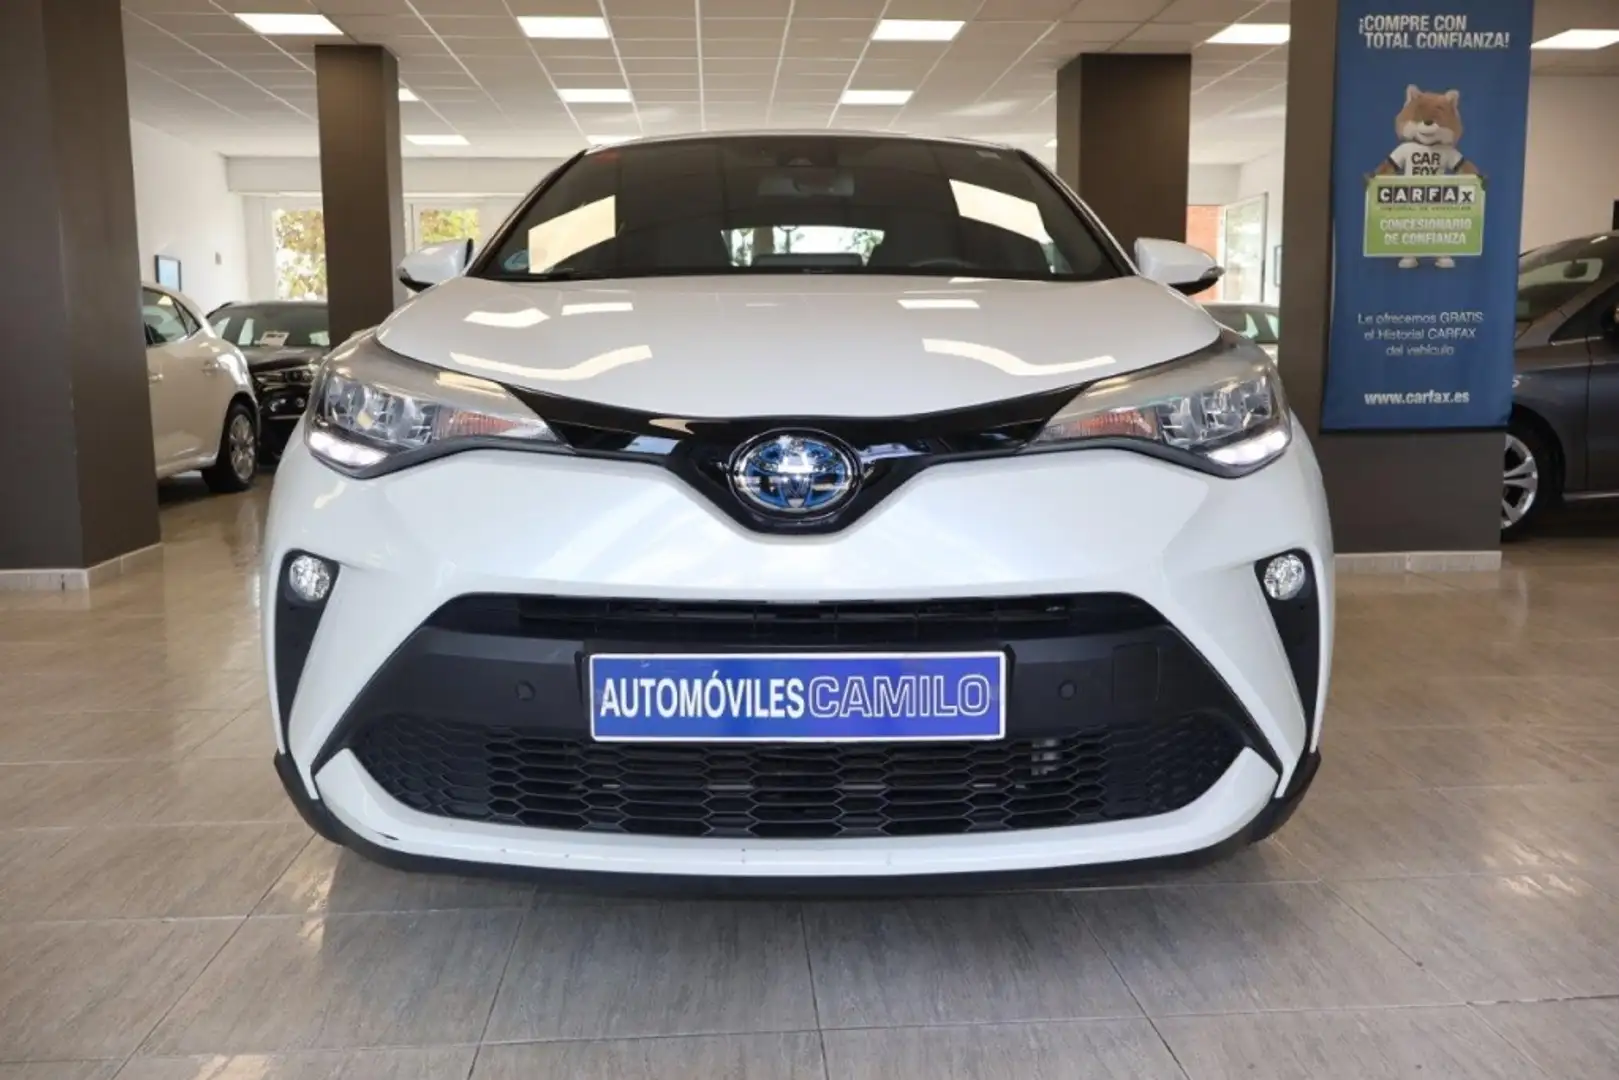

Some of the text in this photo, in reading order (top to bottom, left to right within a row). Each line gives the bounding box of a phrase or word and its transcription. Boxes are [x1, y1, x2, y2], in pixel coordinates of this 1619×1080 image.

[1358, 15, 1467, 34] ¡COMPRE CON
[1364, 32, 1510, 48] TOTAL CONFIANZA!
[1411, 152, 1441, 165] CAR
[1380, 218, 1472, 231] CONCESIONARIO
[1384, 232, 1467, 245] DE CONFIANZA
[1358, 312, 1484, 324] Le ofrecemos GRATIS
[1364, 328, 1477, 340] el Historial CARFAX
[1386, 345, 1403, 356] del
[1364, 389, 1470, 405] www.carfax.es
[600, 671, 990, 718] AUTOMÓVILES CAMILO
